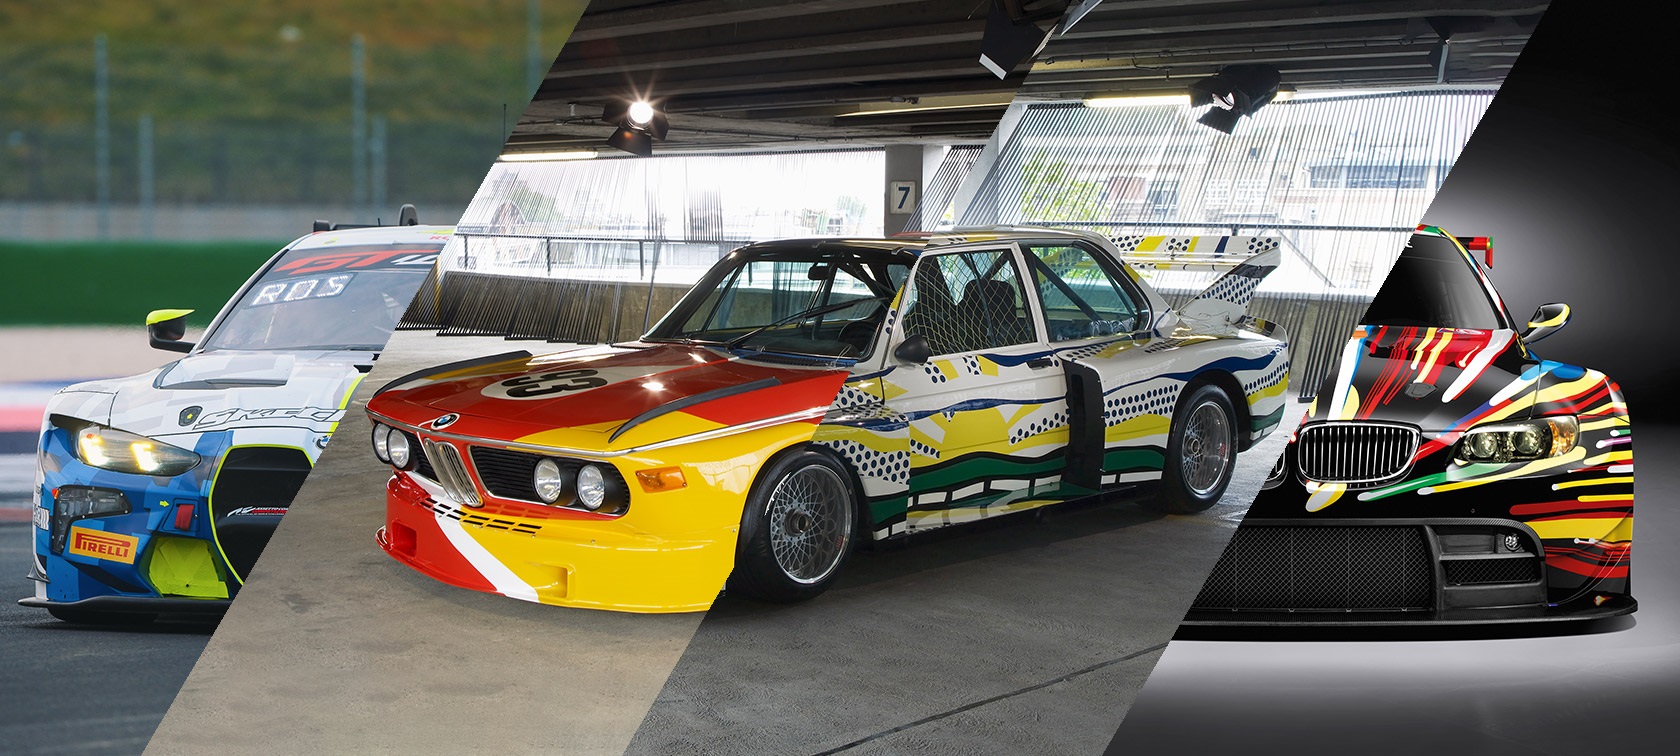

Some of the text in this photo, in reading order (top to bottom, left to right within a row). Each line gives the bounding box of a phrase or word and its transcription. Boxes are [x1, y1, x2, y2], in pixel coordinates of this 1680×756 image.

[898, 187, 910, 209] 7
[273, 249, 440, 275] GT
[252, 275, 348, 305] ROS
[501, 369, 608, 398] 93
[75, 532, 131, 558] PIRELLI
